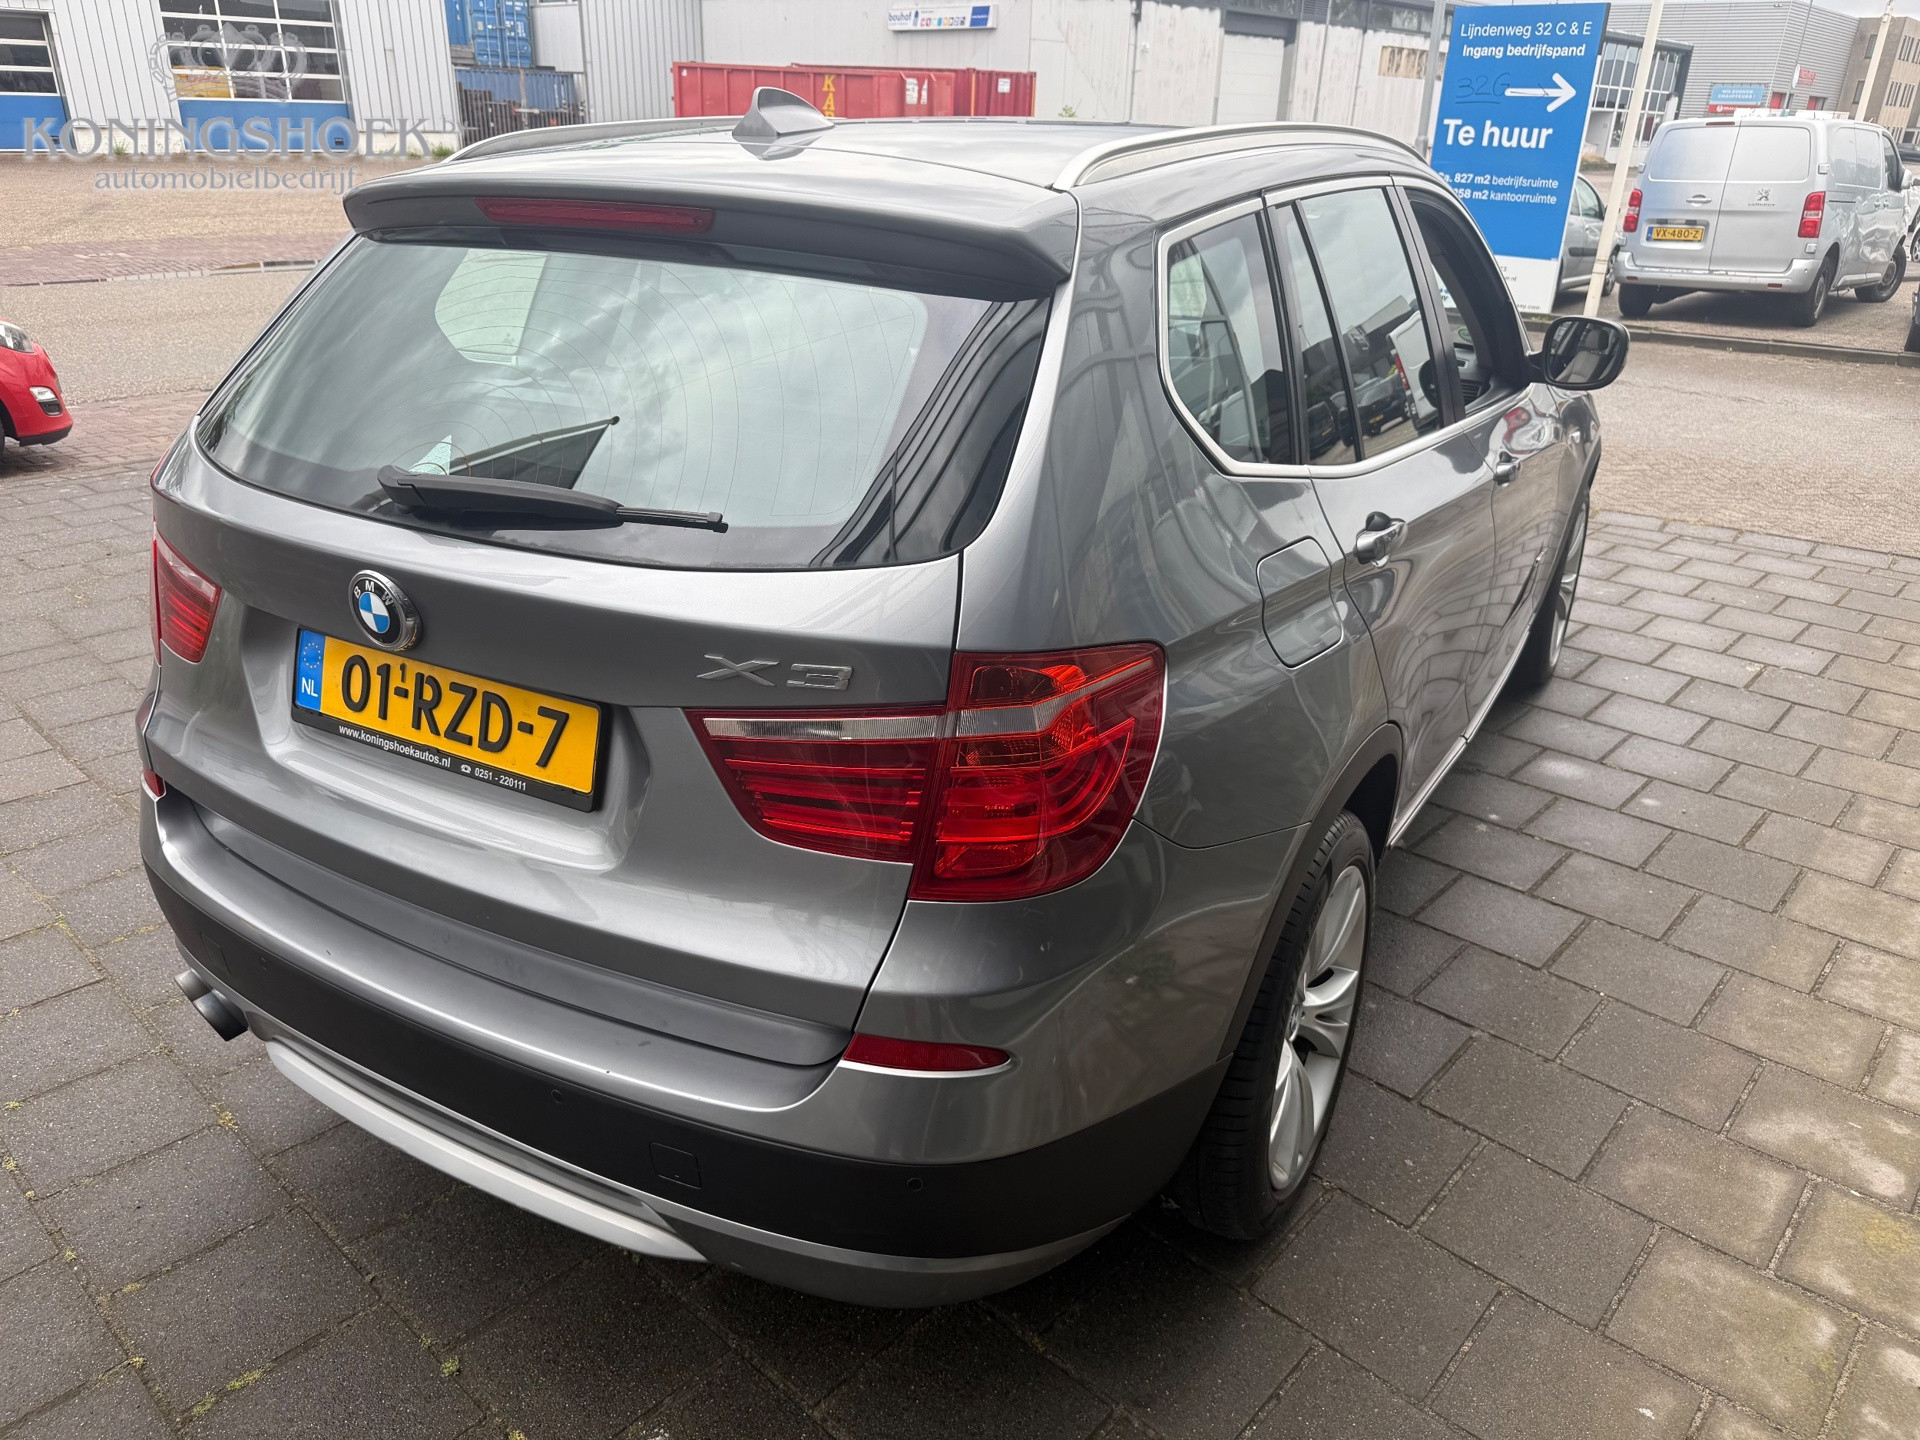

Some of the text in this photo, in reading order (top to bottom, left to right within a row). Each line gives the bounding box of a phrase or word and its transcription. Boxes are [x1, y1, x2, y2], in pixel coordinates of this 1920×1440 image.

[1460, 21, 1593, 40] Lijndenweg 32 C & E
[1462, 43, 1586, 59] Ingang bedrijfspand
[1443, 118, 1553, 149] Te huur
[1454, 172, 1474, 184] 827
[1474, 174, 1491, 185] m2
[1491, 174, 1559, 189] bedrijfsruimte
[1472, 189, 1489, 200] m2
[1489, 188, 1557, 204] kantoorruimte
[1655, 228, 1699, 239] VX-480-Z
[353, 580, 394, 606] BMW
[696, 654, 852, 691] X3
[301, 654, 570, 768] NL 01-RZD-7
[338, 724, 451, 768] www.koningshoekautos.nl
[474, 767, 493, 781] 0251
[499, 774, 527, 791] 220111
